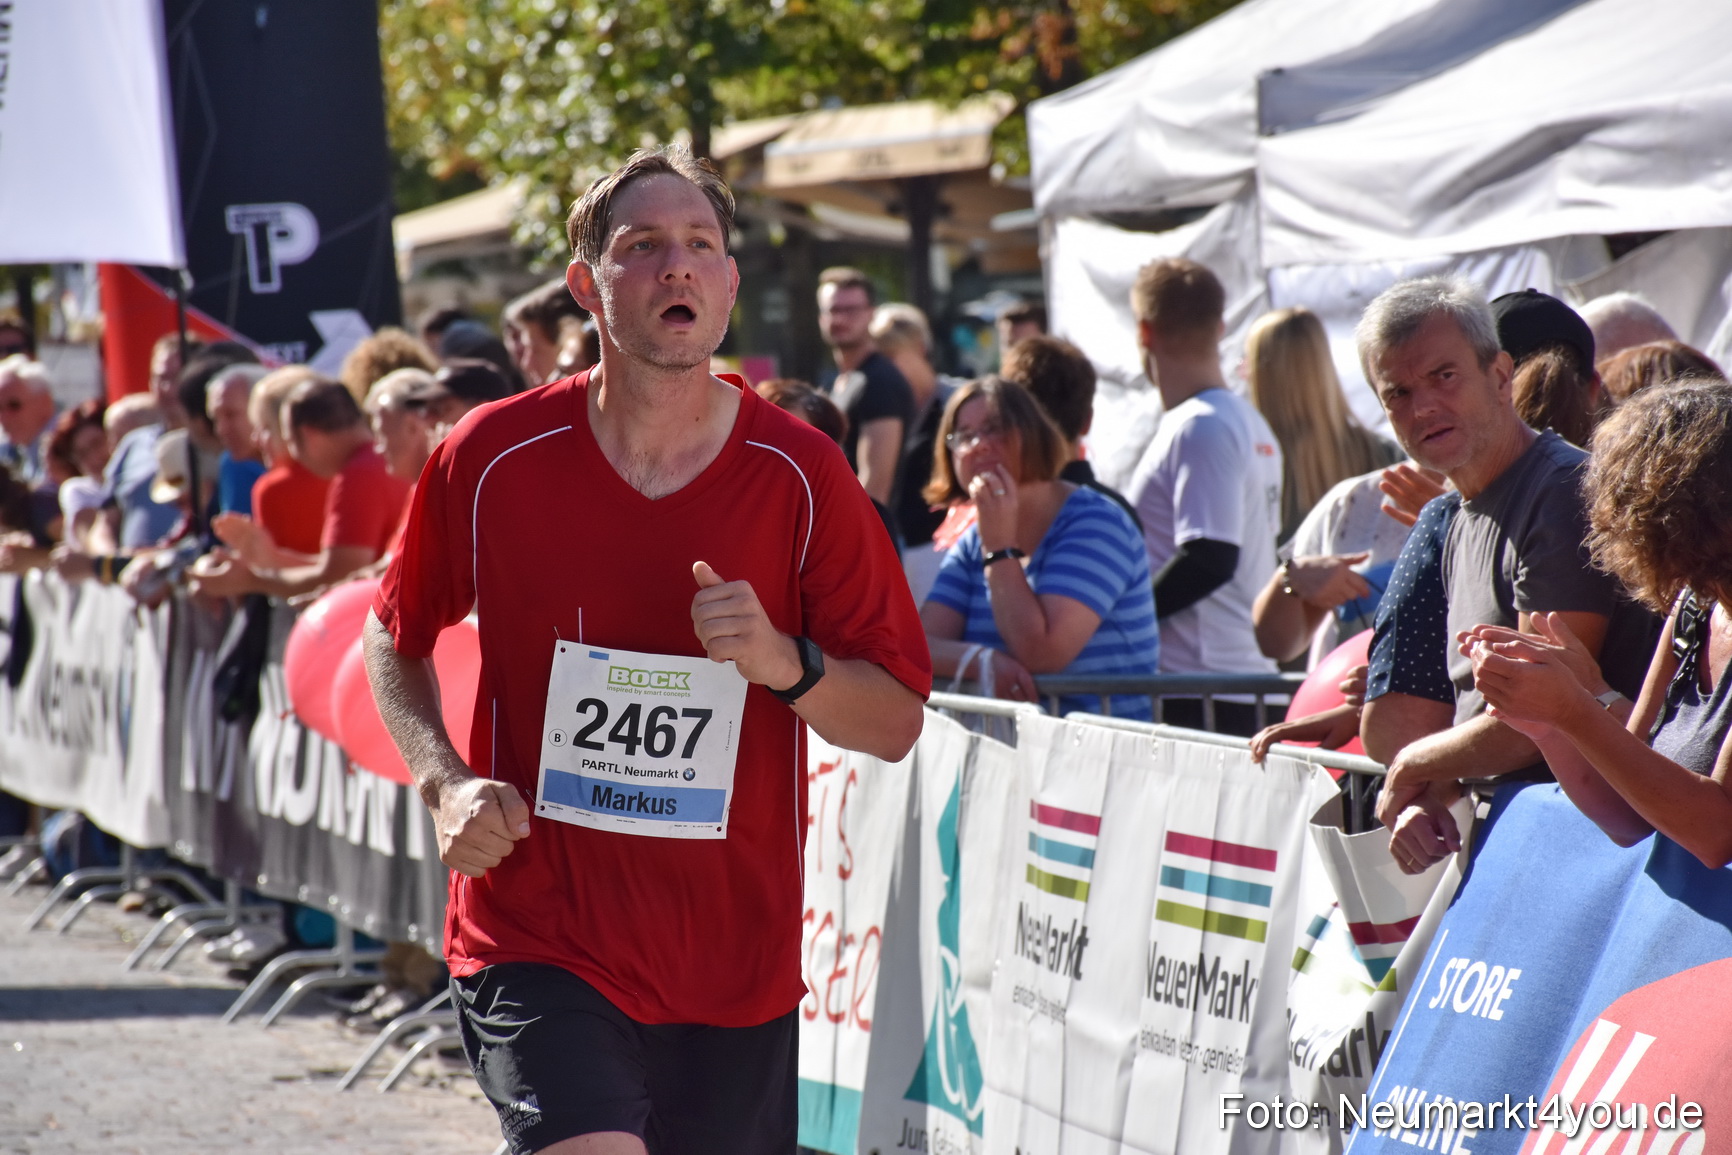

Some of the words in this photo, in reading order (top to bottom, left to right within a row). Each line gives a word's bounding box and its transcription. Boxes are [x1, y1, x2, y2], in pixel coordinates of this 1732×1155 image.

[607, 685, 633, 694] inspired
[644, 689, 662, 697] smart
[608, 666, 692, 690] BOCK
[554, 733, 562, 743] B
[572, 698, 713, 759] 2467
[582, 758, 622, 775] PARTL
[624, 766, 679, 779] Neumarkt
[591, 785, 677, 815] Markus
[808, 755, 858, 880] TS
[1146, 940, 1259, 1024] NeuerMark
[1429, 957, 1522, 1021] STORE
